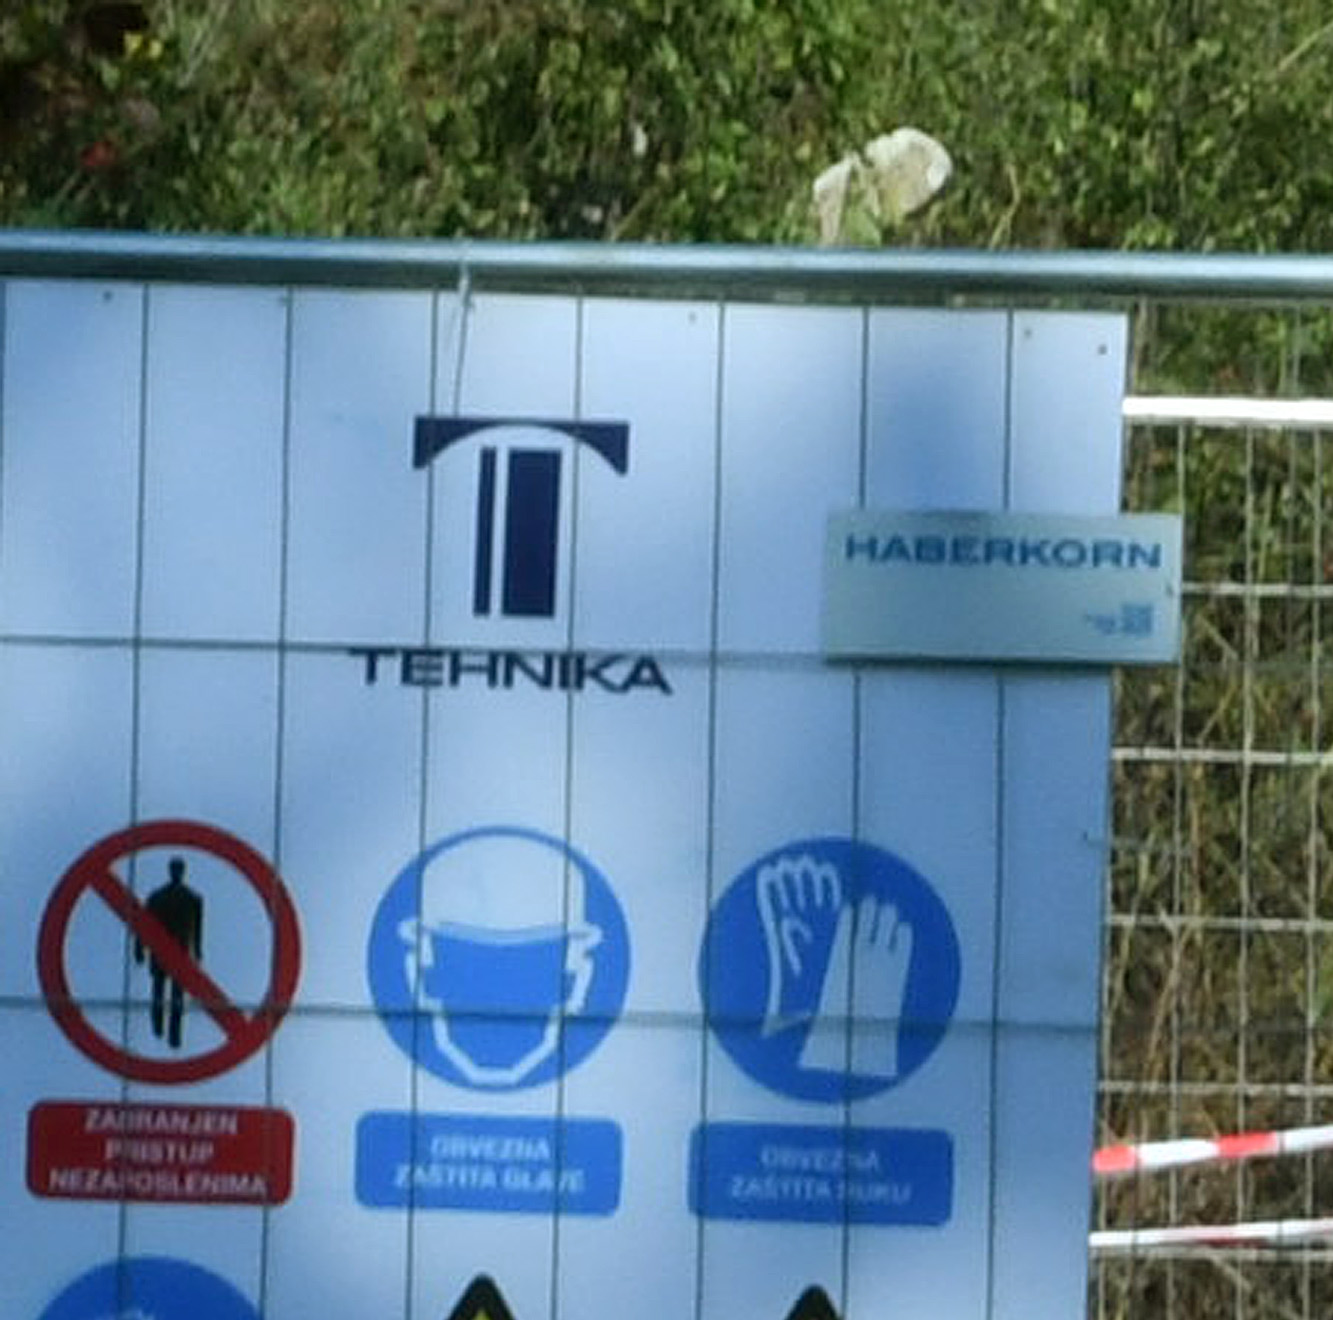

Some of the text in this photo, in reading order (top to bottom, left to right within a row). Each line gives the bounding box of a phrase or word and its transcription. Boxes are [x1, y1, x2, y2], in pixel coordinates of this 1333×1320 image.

[845, 535, 1163, 569] HABERKORN
[347, 646, 674, 697] TEHNIKA
[84, 1107, 239, 1135] ZABRANJEN
[104, 1138, 215, 1164] PRISTUP
[430, 1135, 552, 1162] OBVEZNA
[48, 1166, 268, 1196] NEZAPOSLENIMA
